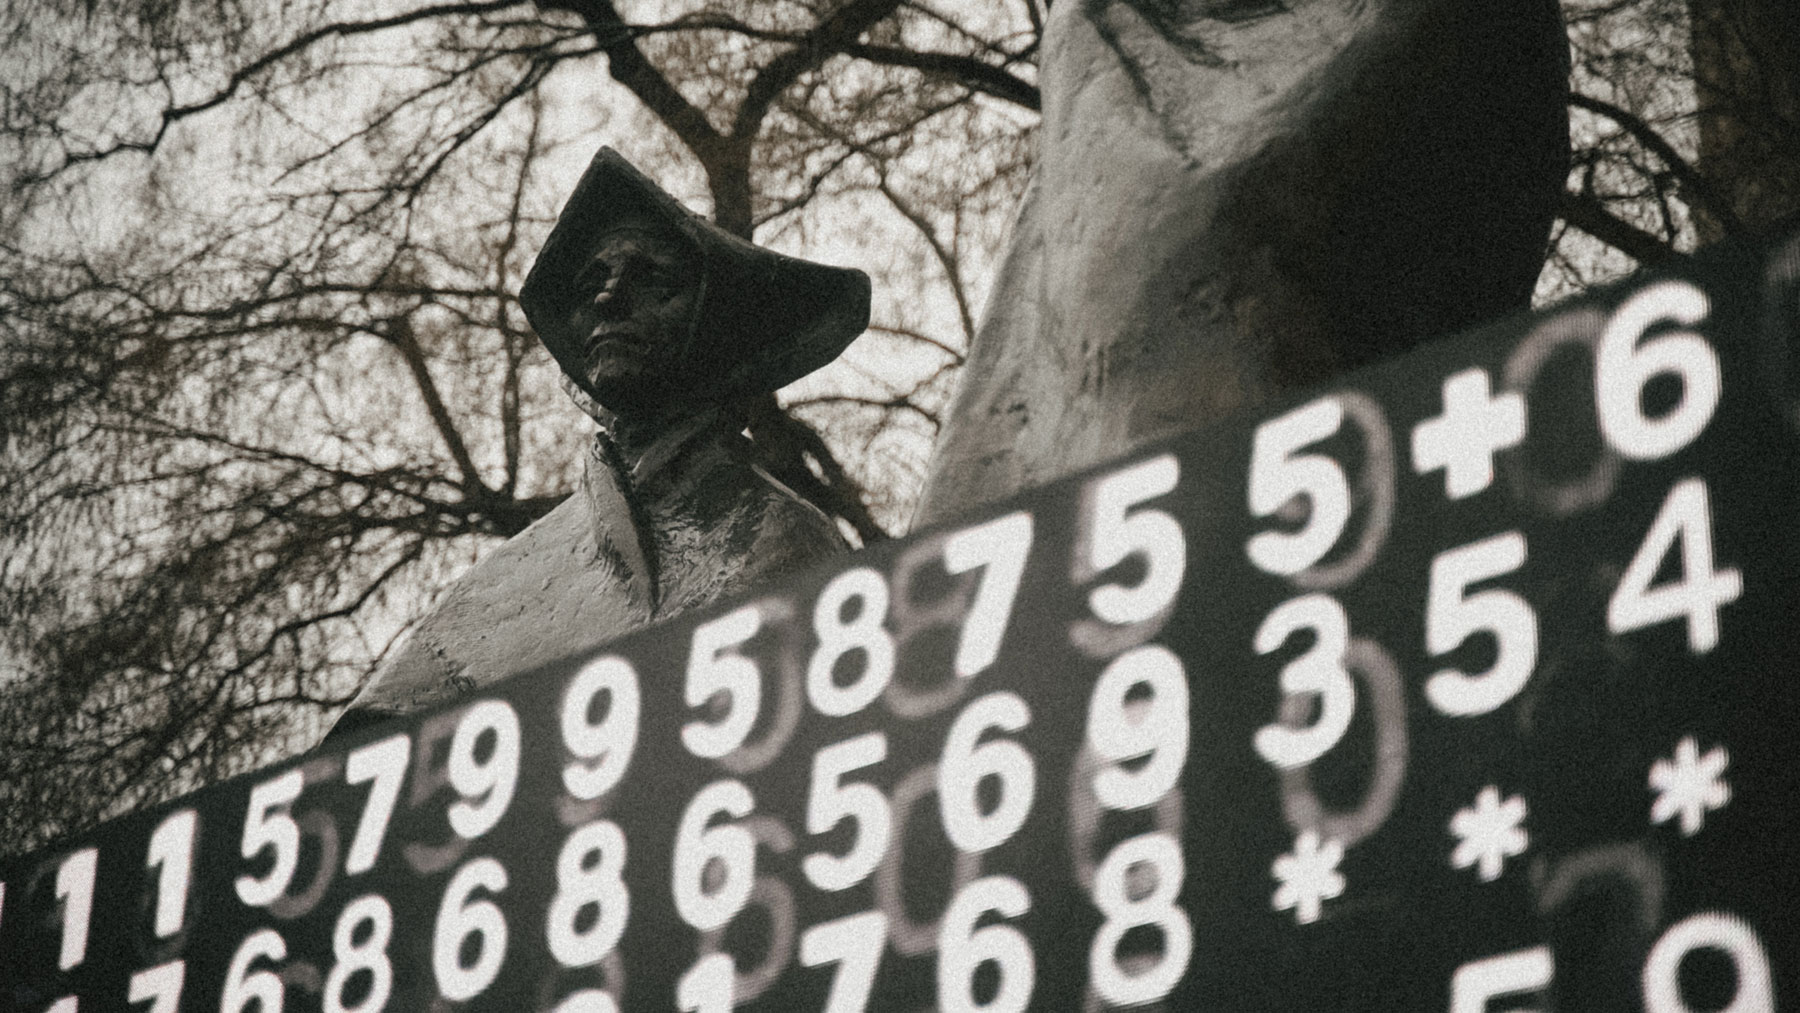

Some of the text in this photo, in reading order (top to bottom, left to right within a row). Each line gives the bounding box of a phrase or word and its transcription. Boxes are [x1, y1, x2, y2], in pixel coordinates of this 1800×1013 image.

[56, 849, 98, 969] 1
[148, 811, 196, 937] 1
[235, 769, 305, 906] 5
[345, 734, 411, 874] 7
[447, 699, 521, 840] 9
[560, 655, 641, 801] 9
[681, 607, 762, 760] 5
[806, 567, 897, 717] 8
[940, 512, 1034, 679] 7
[1088, 455, 1187, 626] 5
[1248, 397, 1347, 576] 5
[1595, 283, 1720, 458] 6
[323, 895, 393, 1013] 8
[432, 858, 508, 1002] 6
[547, 820, 630, 968] 8
[672, 779, 757, 933] 6
[803, 732, 896, 892] 5
[938, 691, 1036, 856] 6
[1088, 645, 1190, 811] 9
[1255, 594, 1355, 769] 3
[1426, 533, 1538, 716] 5
[1608, 480, 1741, 651] 4
[937, 875, 1036, 1013] 6
[1090, 831, 1192, 1006] 8
